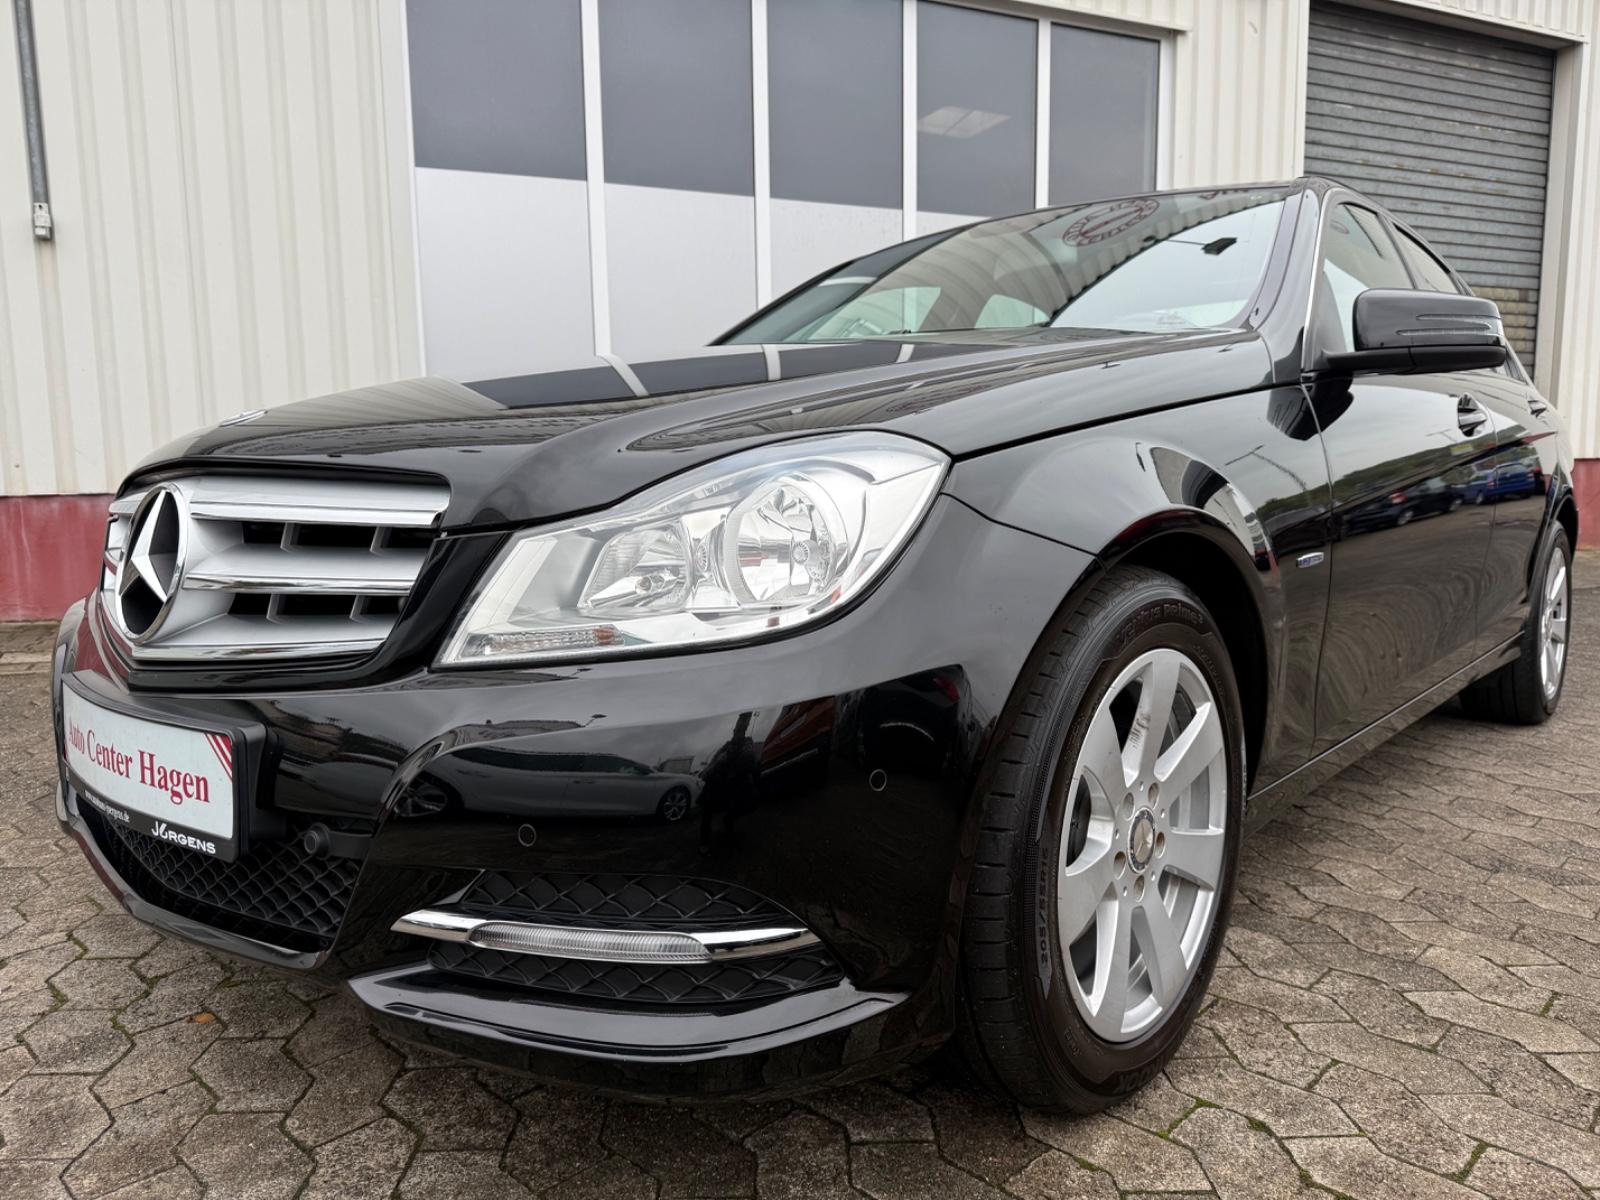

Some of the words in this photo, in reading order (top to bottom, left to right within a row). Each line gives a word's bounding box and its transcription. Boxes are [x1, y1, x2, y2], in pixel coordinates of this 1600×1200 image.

[68, 719, 85, 755] Auto
[87, 730, 133, 779] Center
[139, 750, 210, 805] Hagen
